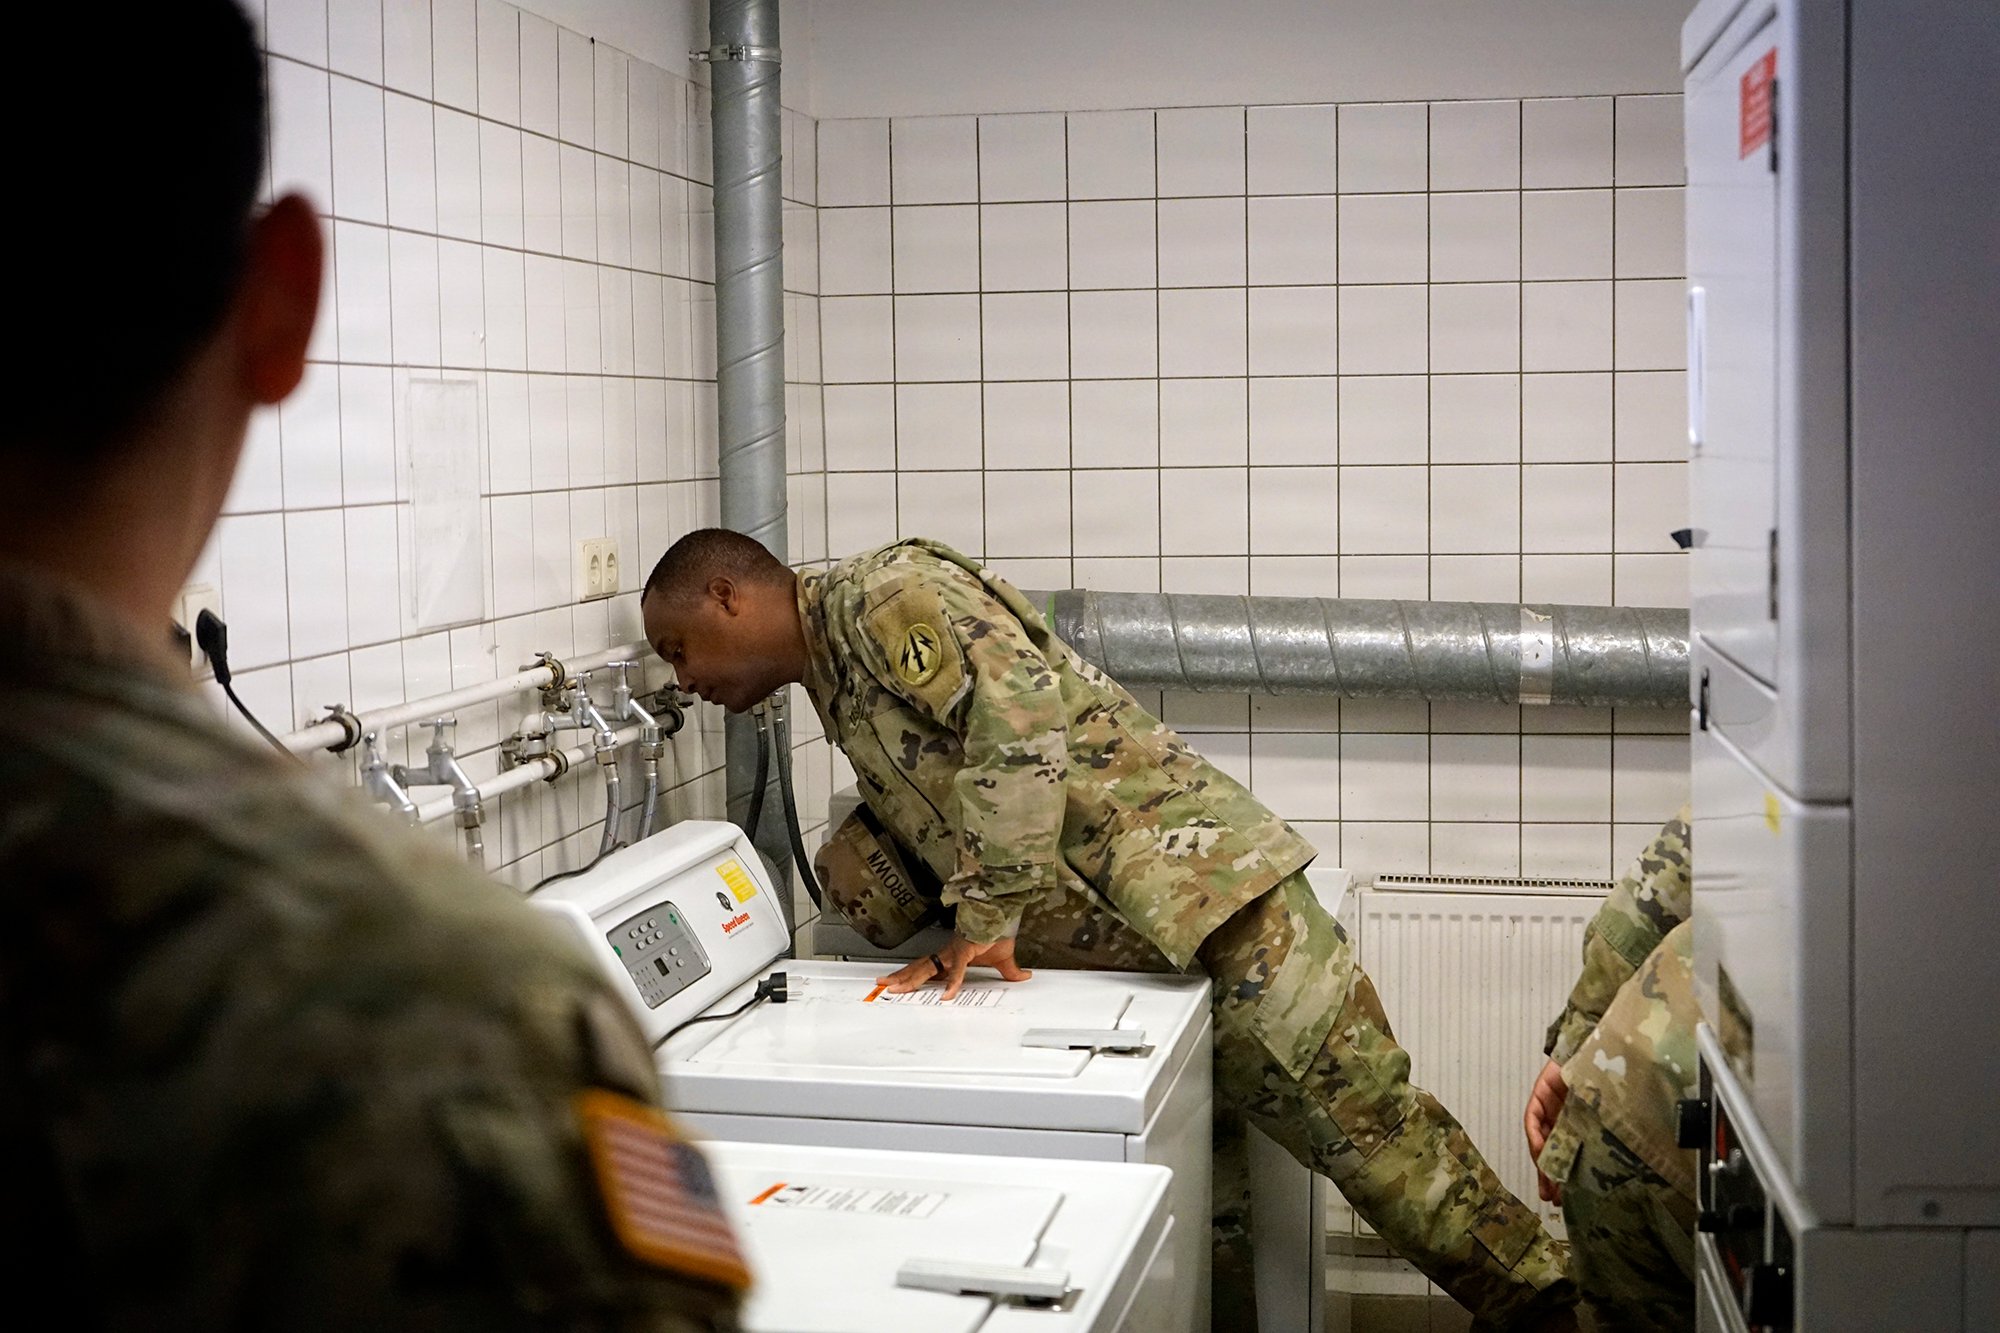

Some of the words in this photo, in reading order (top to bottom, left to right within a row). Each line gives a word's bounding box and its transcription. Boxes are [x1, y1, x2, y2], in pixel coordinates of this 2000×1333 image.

[867, 849, 914, 907] BROWN
[721, 917, 738, 934] Speed
[734, 912, 751, 925] Queen
